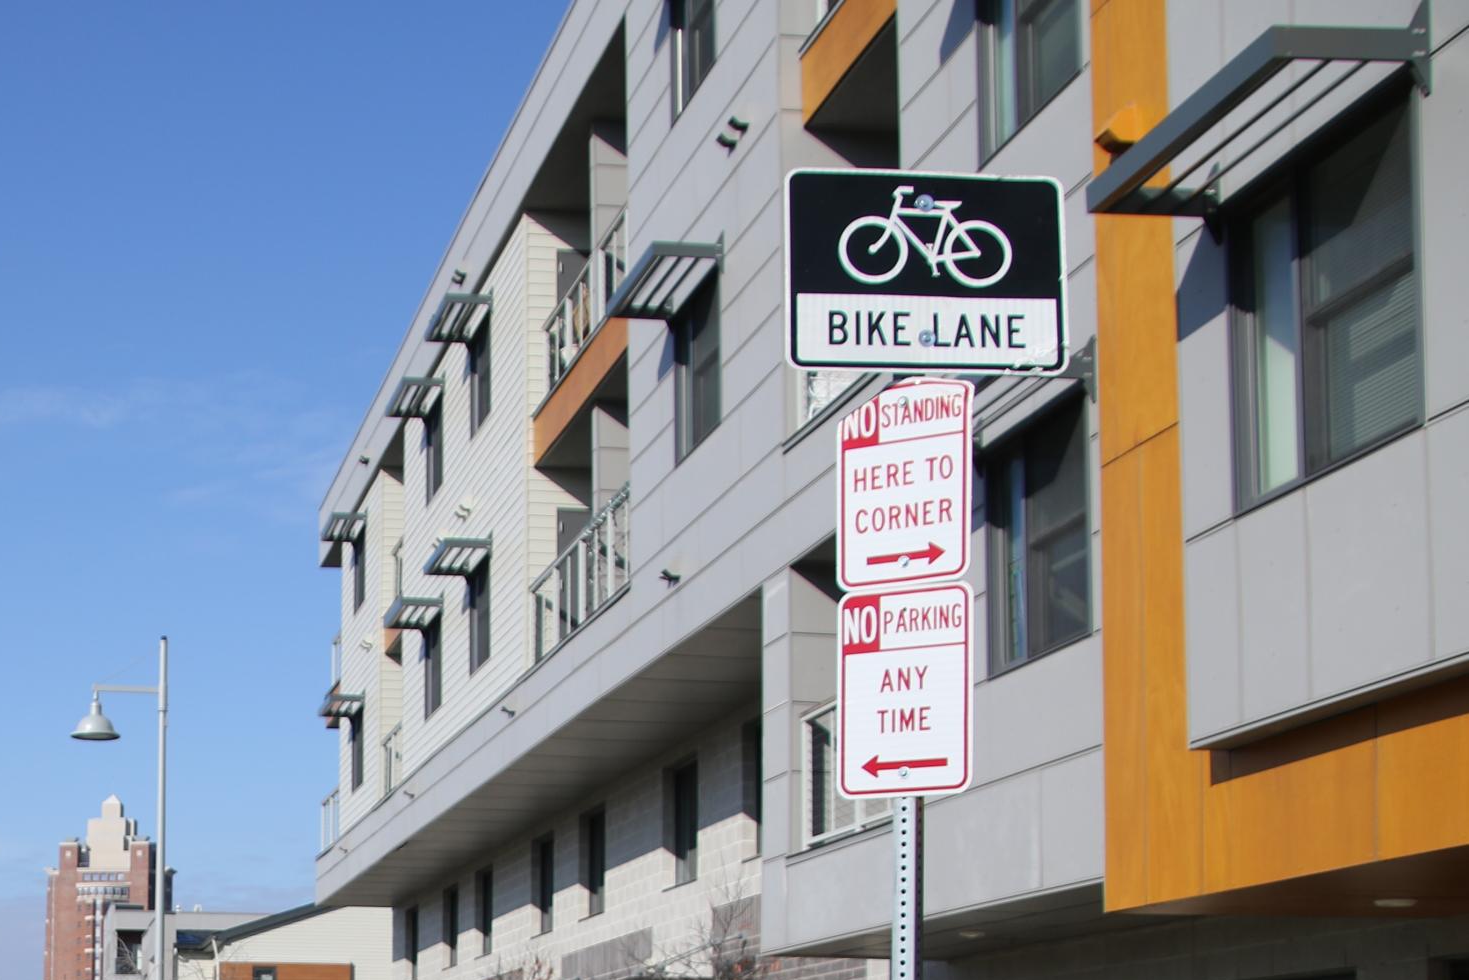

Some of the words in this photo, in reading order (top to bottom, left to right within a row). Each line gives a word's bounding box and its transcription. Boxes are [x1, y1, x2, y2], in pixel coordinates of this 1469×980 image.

[828, 310, 912, 346] BIKE
[932, 313, 1027, 349] LANE
[842, 399, 878, 441] NO
[881, 393, 963, 429] STANDING
[853, 460, 915, 493] HERE
[925, 454, 954, 482] TO
[855, 497, 953, 535] CORNER
[843, 605, 878, 646] NO
[883, 602, 963, 635] PARKING
[880, 664, 929, 694] ANY
[877, 705, 932, 735] TIME
